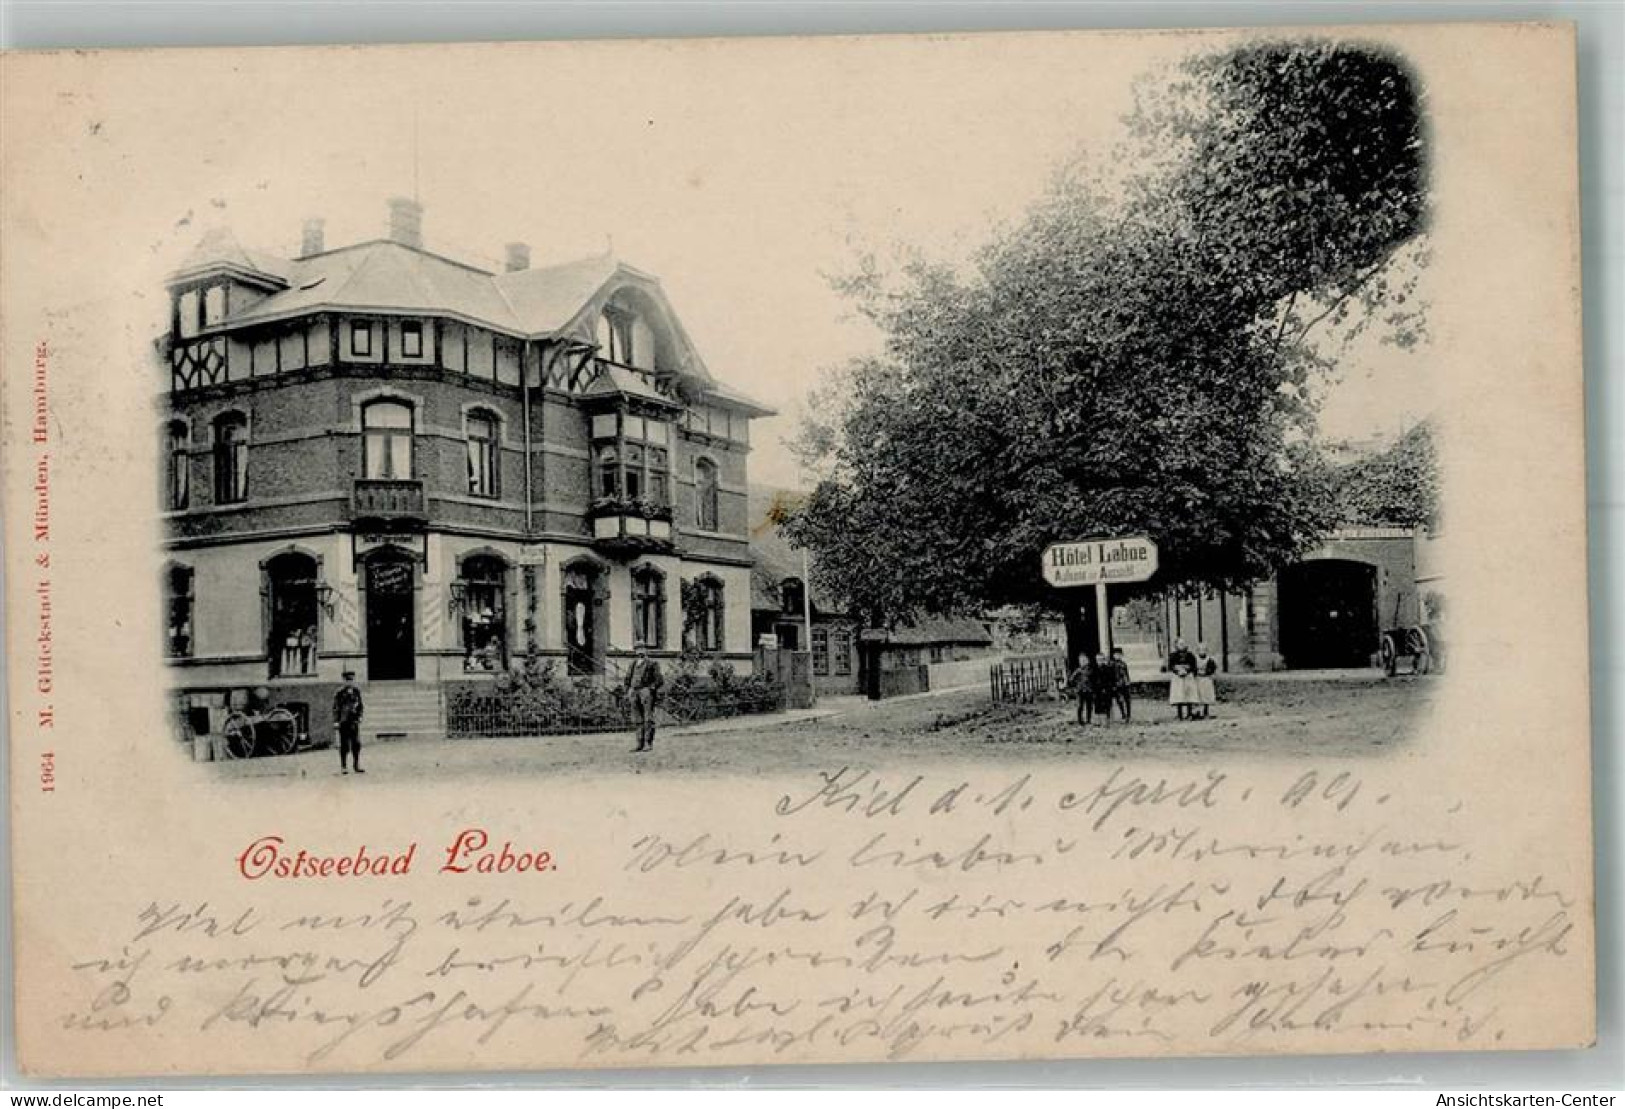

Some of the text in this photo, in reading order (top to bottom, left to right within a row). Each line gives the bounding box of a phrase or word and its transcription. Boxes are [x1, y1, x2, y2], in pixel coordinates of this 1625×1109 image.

[33, 341, 48, 443] Hamburg.
[36, 553, 49, 568] &
[1098, 542, 1147, 563] Laboe
[36, 582, 52, 693] Glückstadt
[39, 704, 53, 728] M.
[41, 752, 54, 792] 1964
[236, 829, 557, 880] Ostseebad Laboe.
